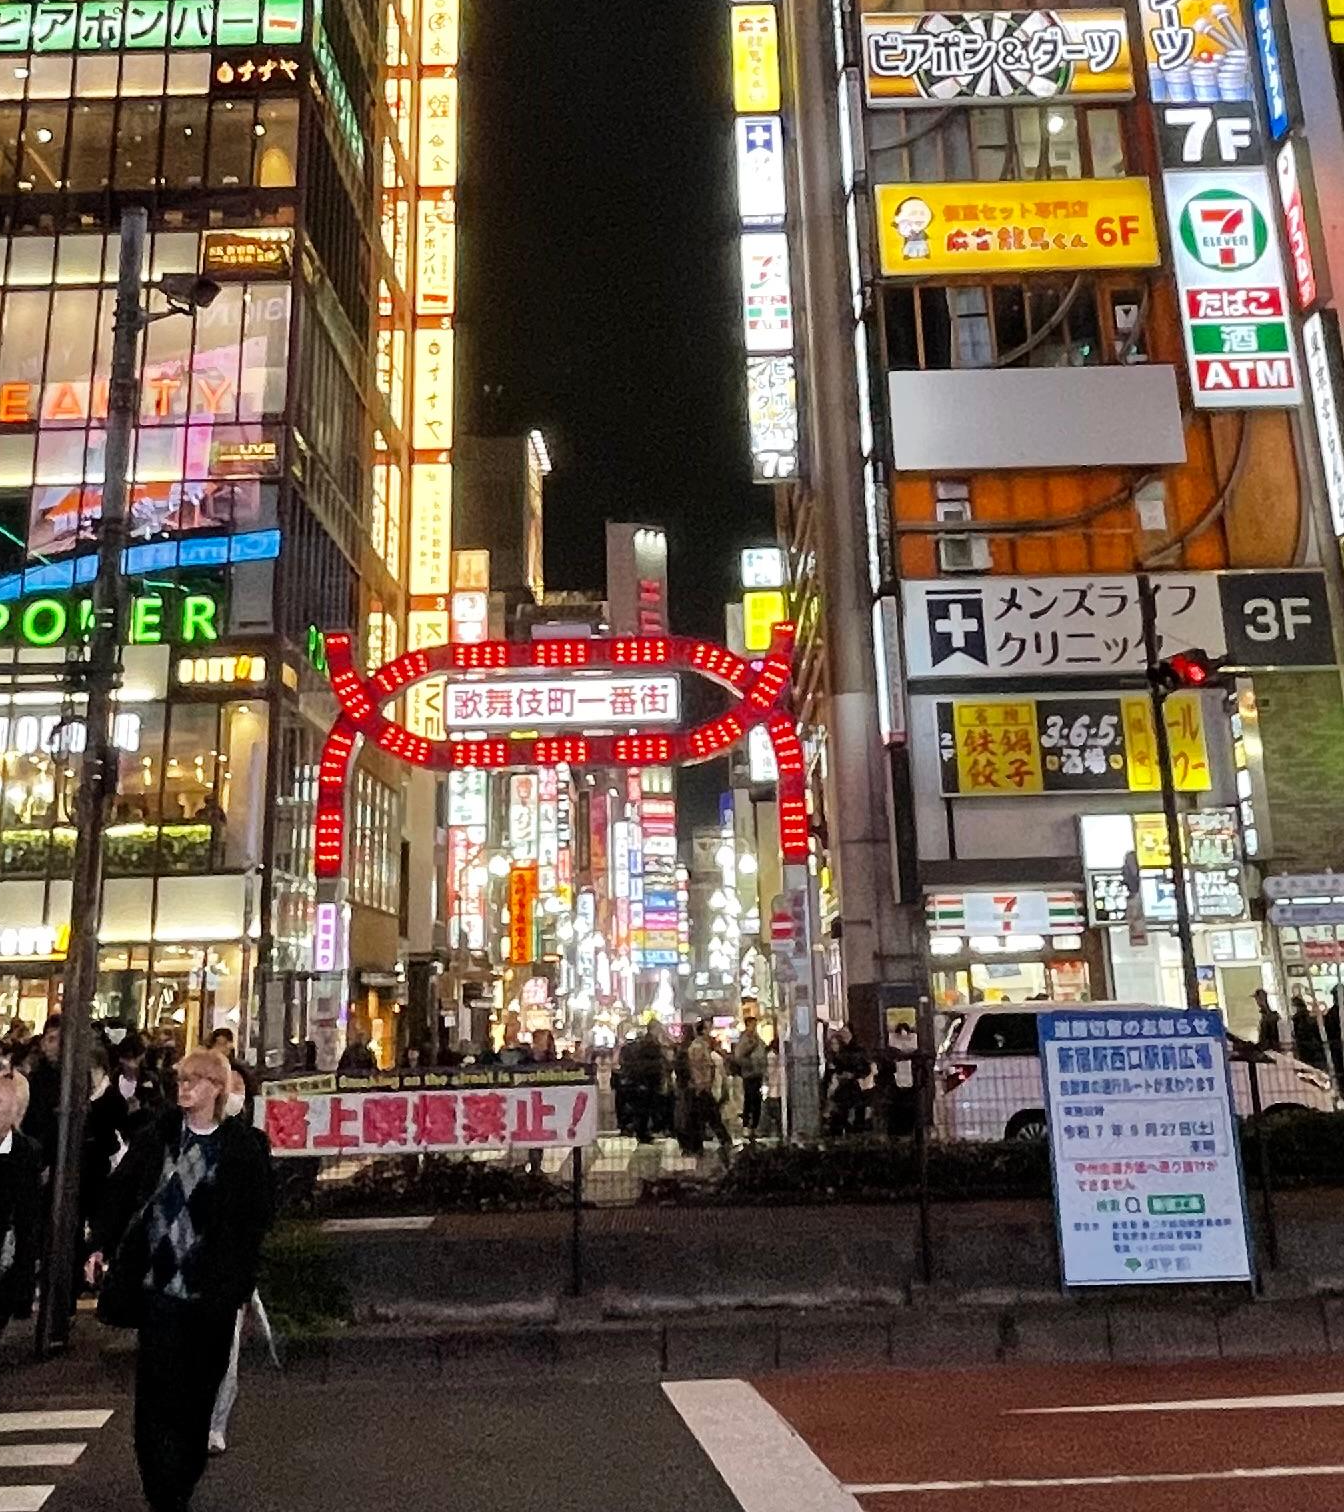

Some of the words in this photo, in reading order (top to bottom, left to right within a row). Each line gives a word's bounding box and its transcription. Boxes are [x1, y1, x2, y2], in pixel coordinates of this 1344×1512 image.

[1164, 107, 1252, 164] 7F
[1094, 215, 1140, 248] 6F
[1196, 290, 1276, 316] たばこ
[1219, 326, 1258, 352] 酒
[1205, 359, 1294, 388] ATM
[758, 452, 795, 478] 7F
[1243, 597, 1312, 642] 3F
[453, 685, 670, 722] 歌舞伎町一番街
